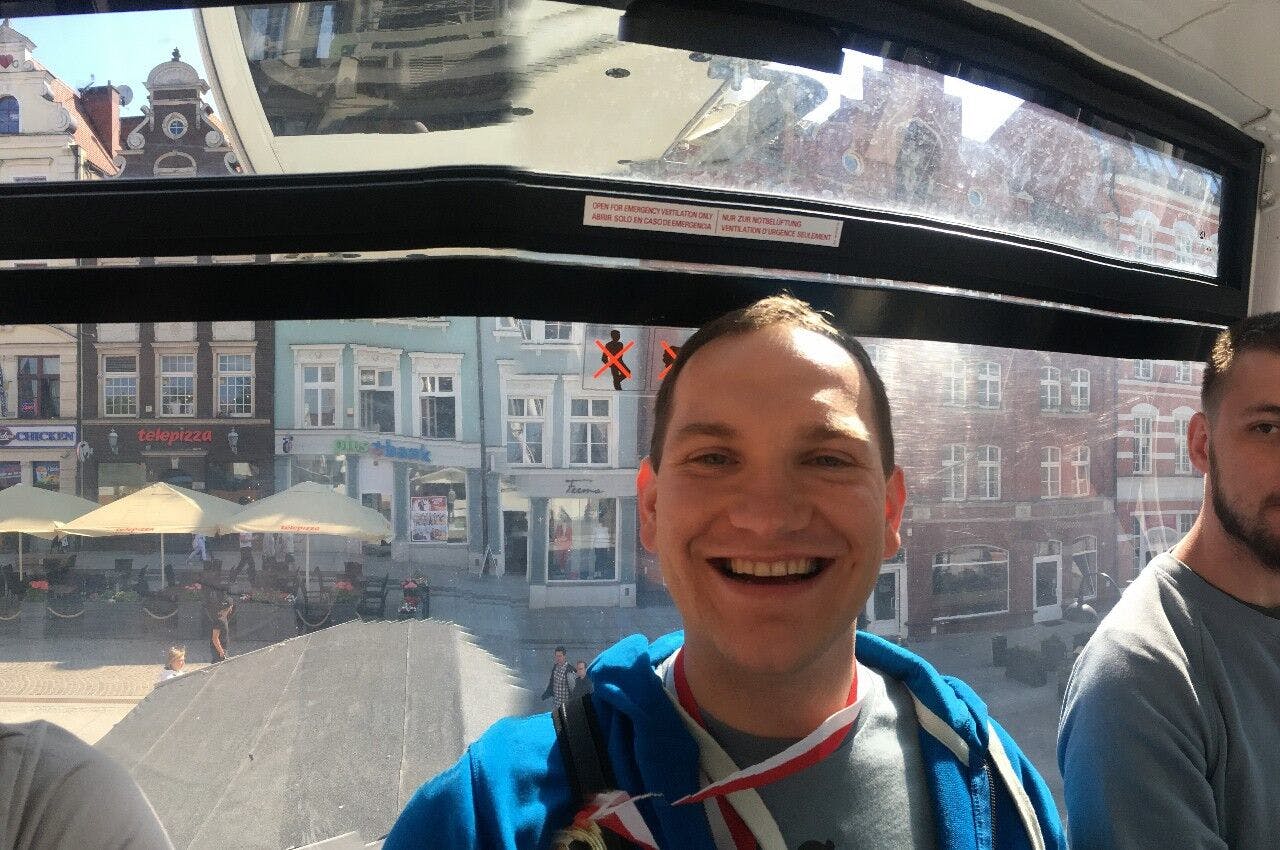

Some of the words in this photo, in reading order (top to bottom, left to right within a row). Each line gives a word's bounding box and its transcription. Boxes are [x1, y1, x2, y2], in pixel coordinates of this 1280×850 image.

[592, 202, 608, 210] OPEN
[610, 204, 623, 212] FOR
[624, 205, 661, 215] EMERGENCY
[698, 211, 713, 220] ONLY
[592, 213, 612, 221] ABRIR
[614, 215, 632, 223] SOLO
[633, 216, 642, 224] EN
[644, 217, 662, 226] CASO
[662, 219, 671, 227] DE
[671, 220, 712, 230] EMERGENCIA
[721, 225, 761, 235] VENTILATION
[797, 231, 832, 241] SEULEMENT
[16, 431, 75, 441] CHICKEN
[138, 428, 213, 447] telepizza
